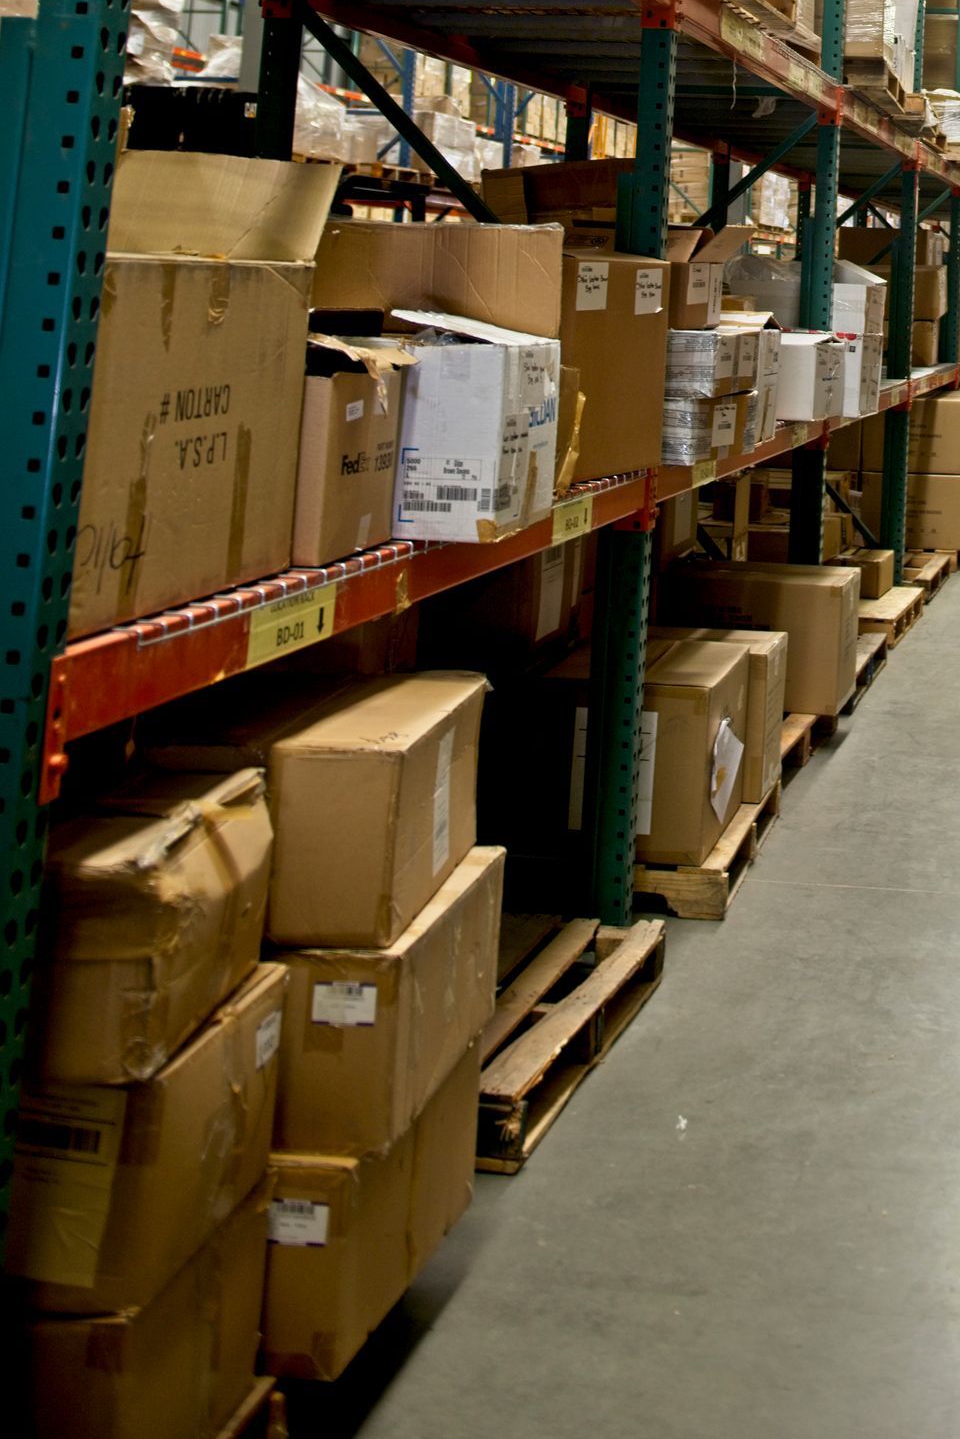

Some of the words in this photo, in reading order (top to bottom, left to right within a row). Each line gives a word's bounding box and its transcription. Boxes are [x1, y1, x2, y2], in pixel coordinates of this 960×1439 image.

[159, 393, 171, 424] #
[174, 384, 231, 423] CARTON
[276, 621, 304, 647] BD-01
